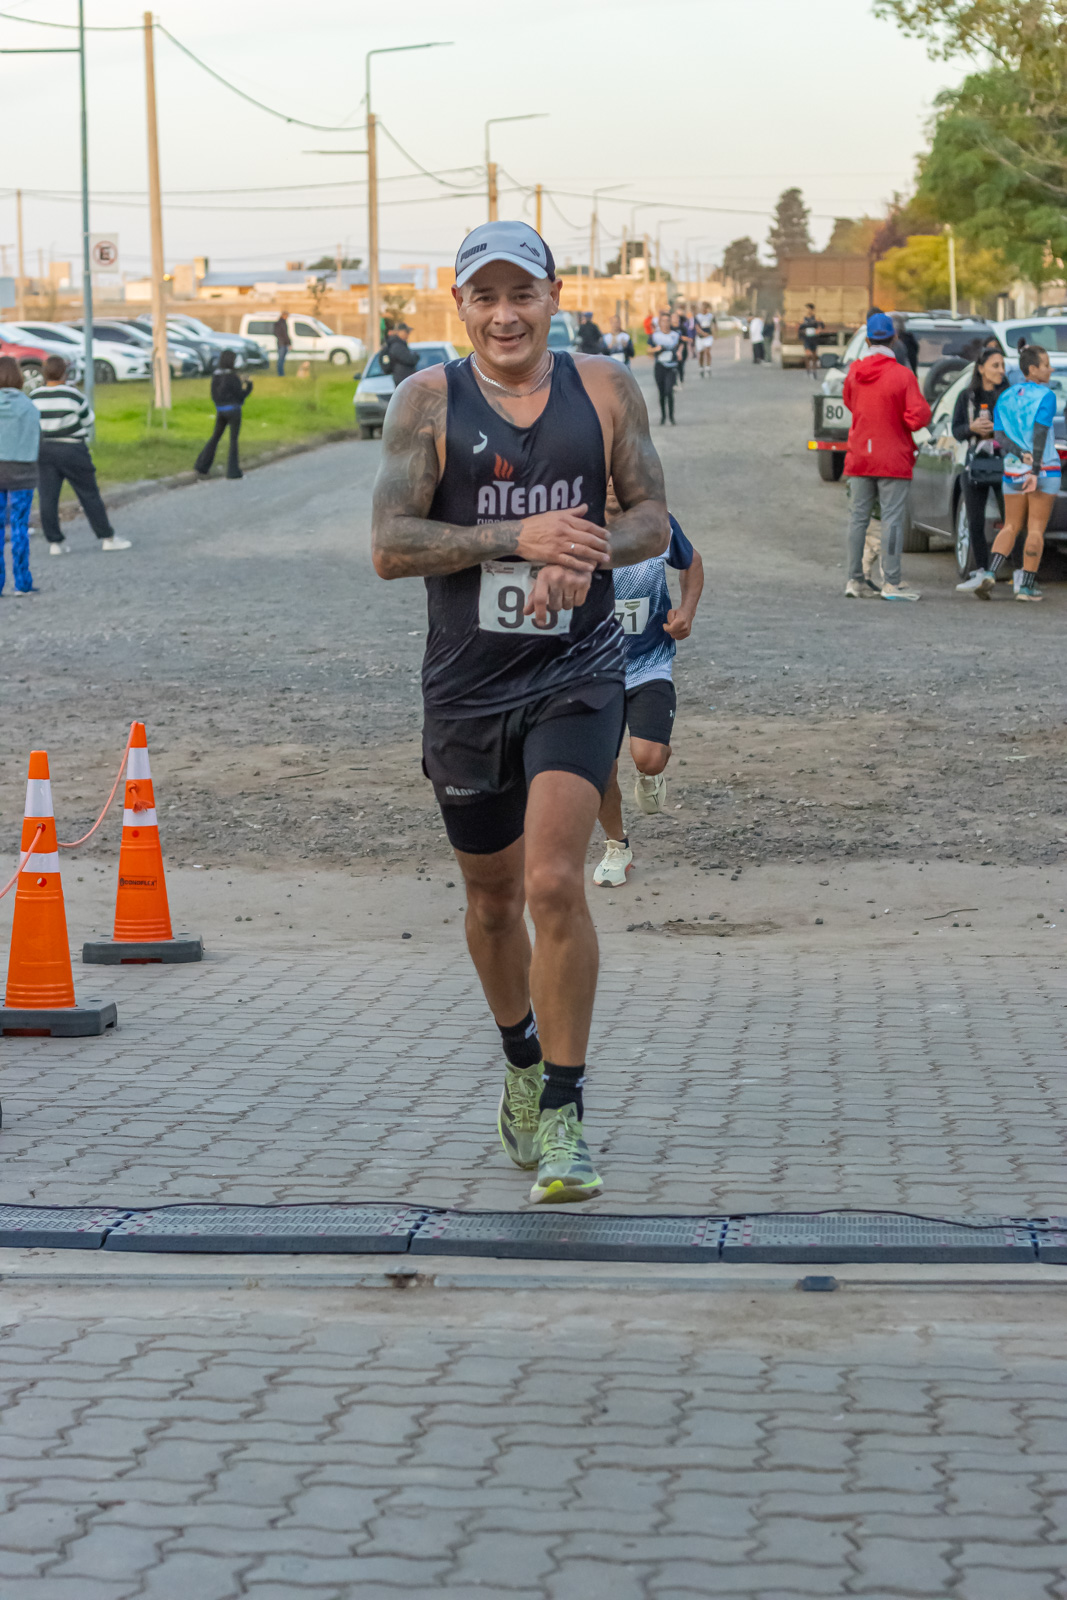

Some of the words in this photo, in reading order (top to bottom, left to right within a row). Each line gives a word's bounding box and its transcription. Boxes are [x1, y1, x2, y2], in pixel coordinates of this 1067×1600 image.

[100, 246, 111, 260] E
[460, 243, 488, 263] PUMA
[826, 405, 844, 420] 80
[477, 475, 583, 516] ATENAS
